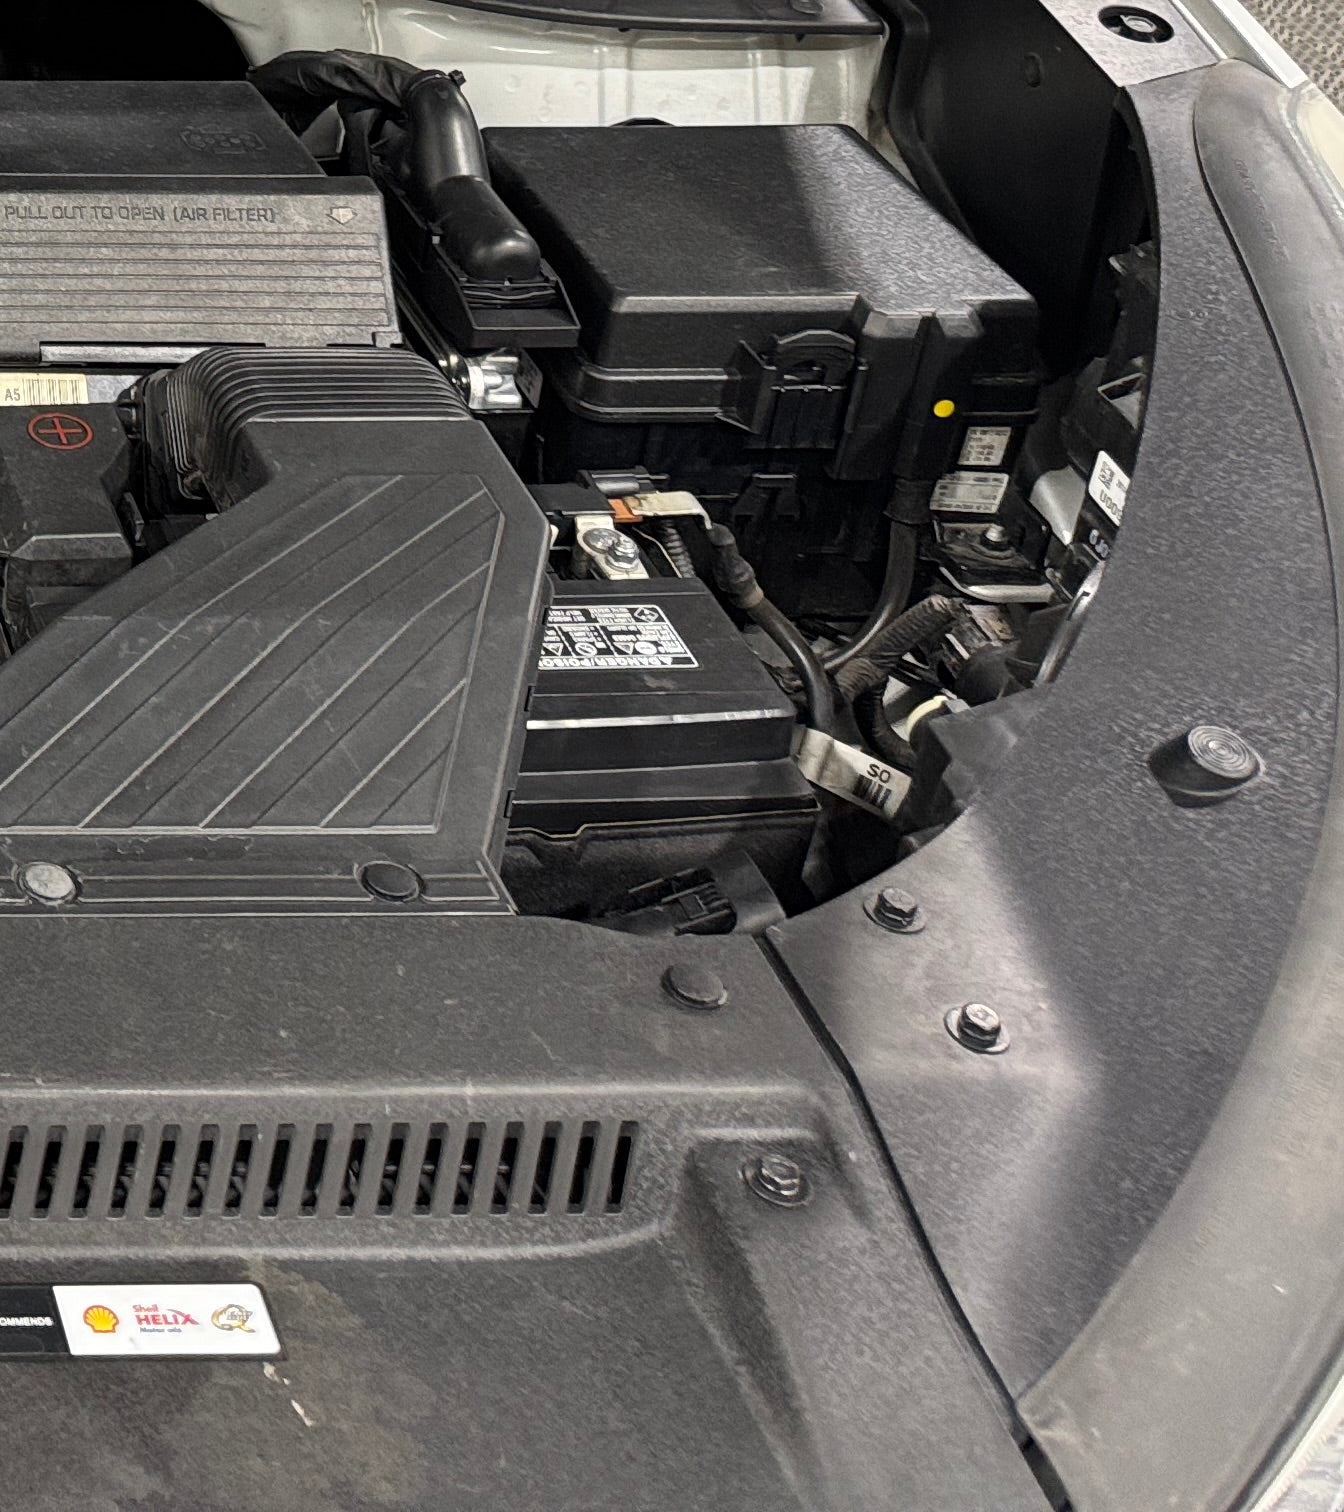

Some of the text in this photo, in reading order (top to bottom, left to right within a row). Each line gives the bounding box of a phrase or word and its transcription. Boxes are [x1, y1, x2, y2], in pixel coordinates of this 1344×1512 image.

[4, 205, 278, 223] PULL OUT TO OPEN (AIR FILTER)
[5, 387, 21, 402] A5
[538, 656, 661, 668] DANGER/POISO
[132, 1304, 160, 1314] Shell
[135, 1311, 200, 1326] HELIX
